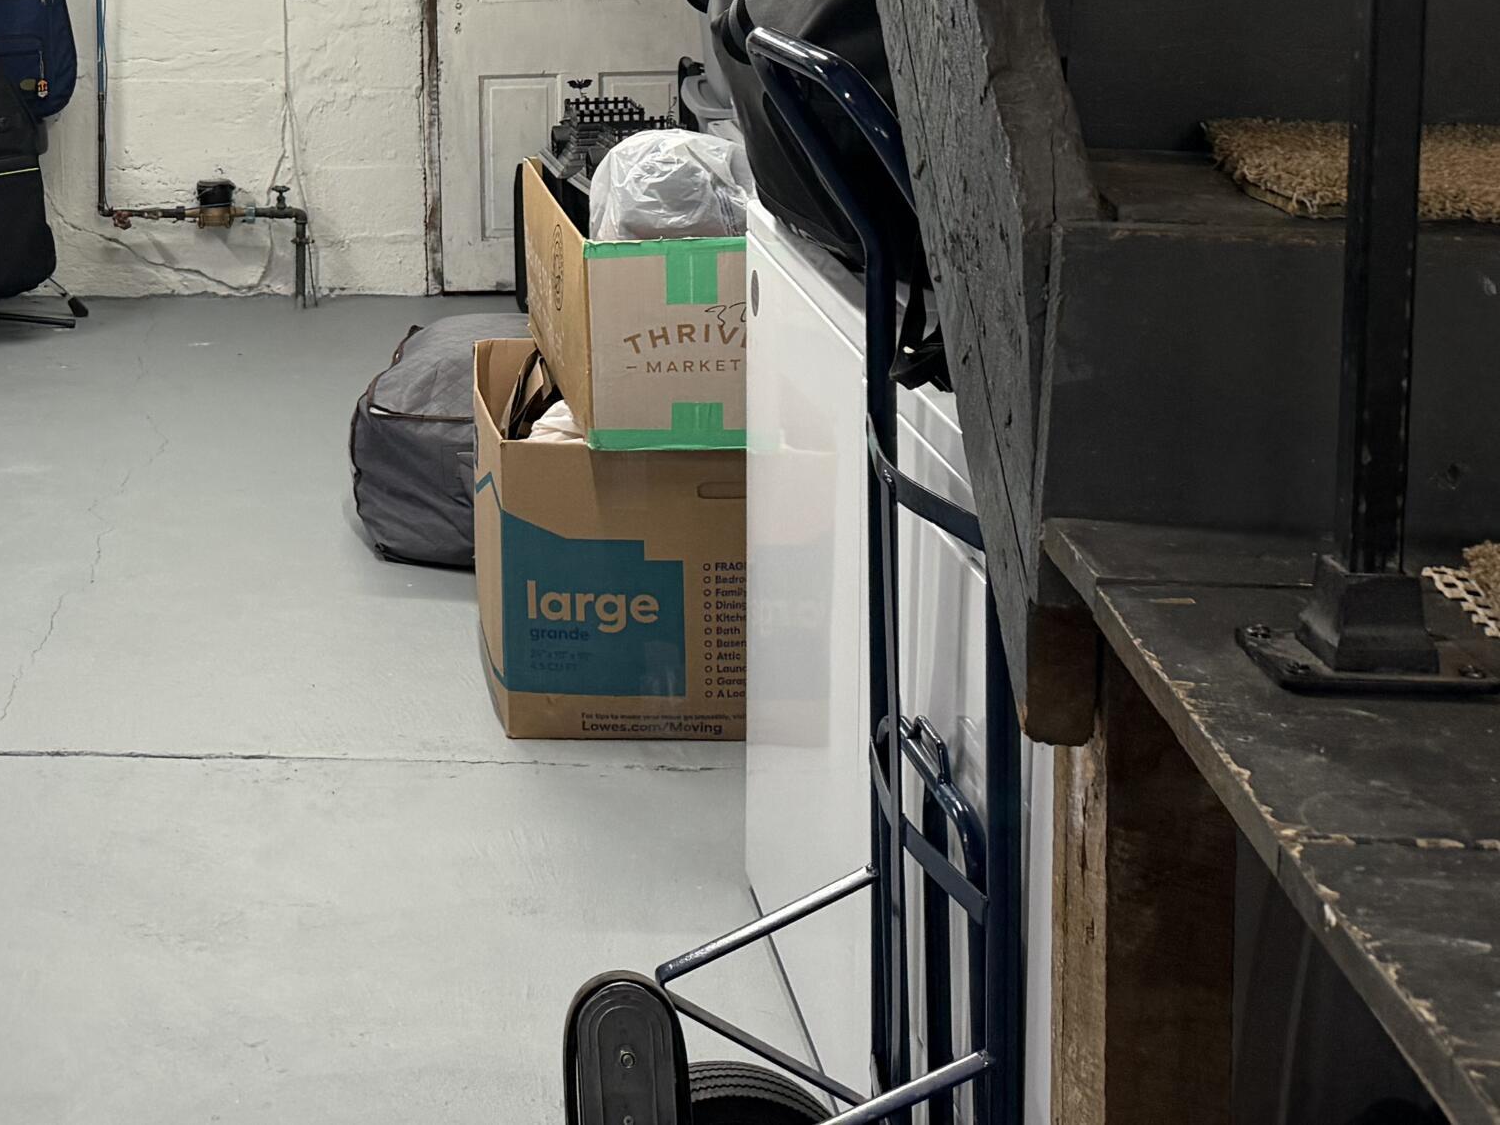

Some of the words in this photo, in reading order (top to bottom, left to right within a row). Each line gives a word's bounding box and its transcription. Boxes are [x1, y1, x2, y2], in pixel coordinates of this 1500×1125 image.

[646, 359, 741, 373] MARKET
[526, 579, 660, 633] large
[530, 627, 589, 641] grande
[716, 627, 740, 635] Bath
[716, 651, 741, 660] Attic
[582, 720, 723, 735] Lowes.com/Moving
